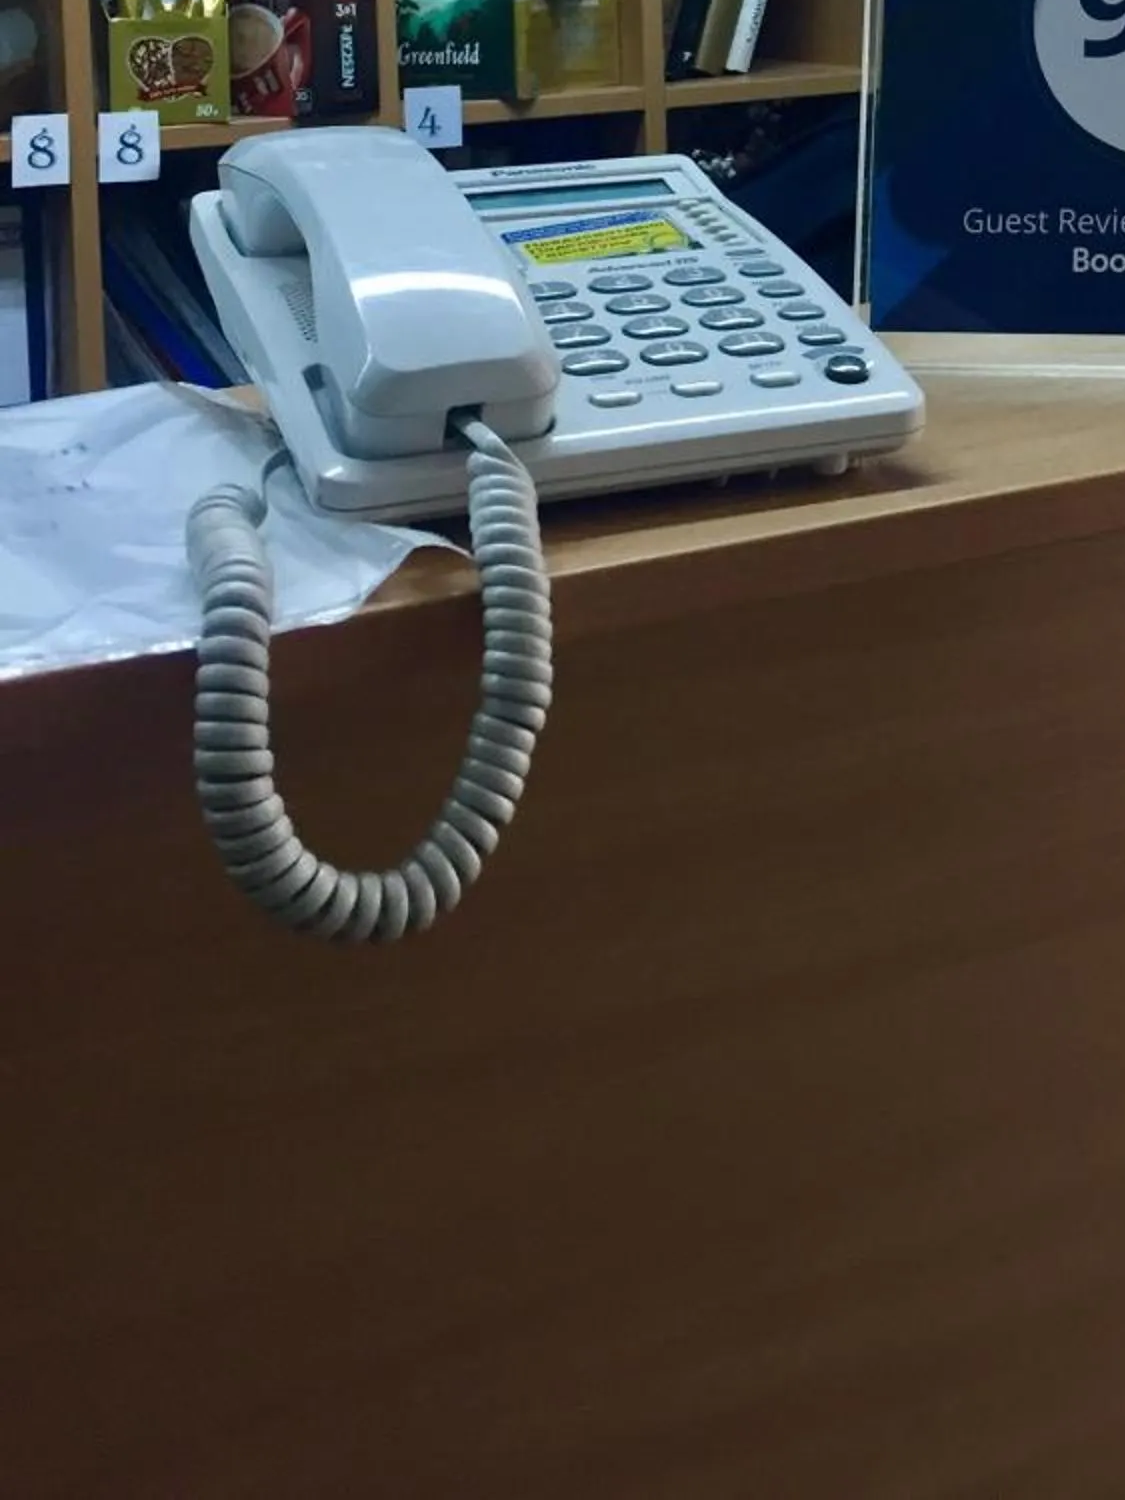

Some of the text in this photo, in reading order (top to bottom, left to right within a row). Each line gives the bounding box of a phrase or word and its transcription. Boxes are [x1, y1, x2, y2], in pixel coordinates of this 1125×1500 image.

[399, 41, 481, 66] Greenfield
[417, 106, 442, 136] 4
[27, 127, 55, 169] 8
[116, 123, 144, 165] 8
[962, 207, 1049, 236] Guest
